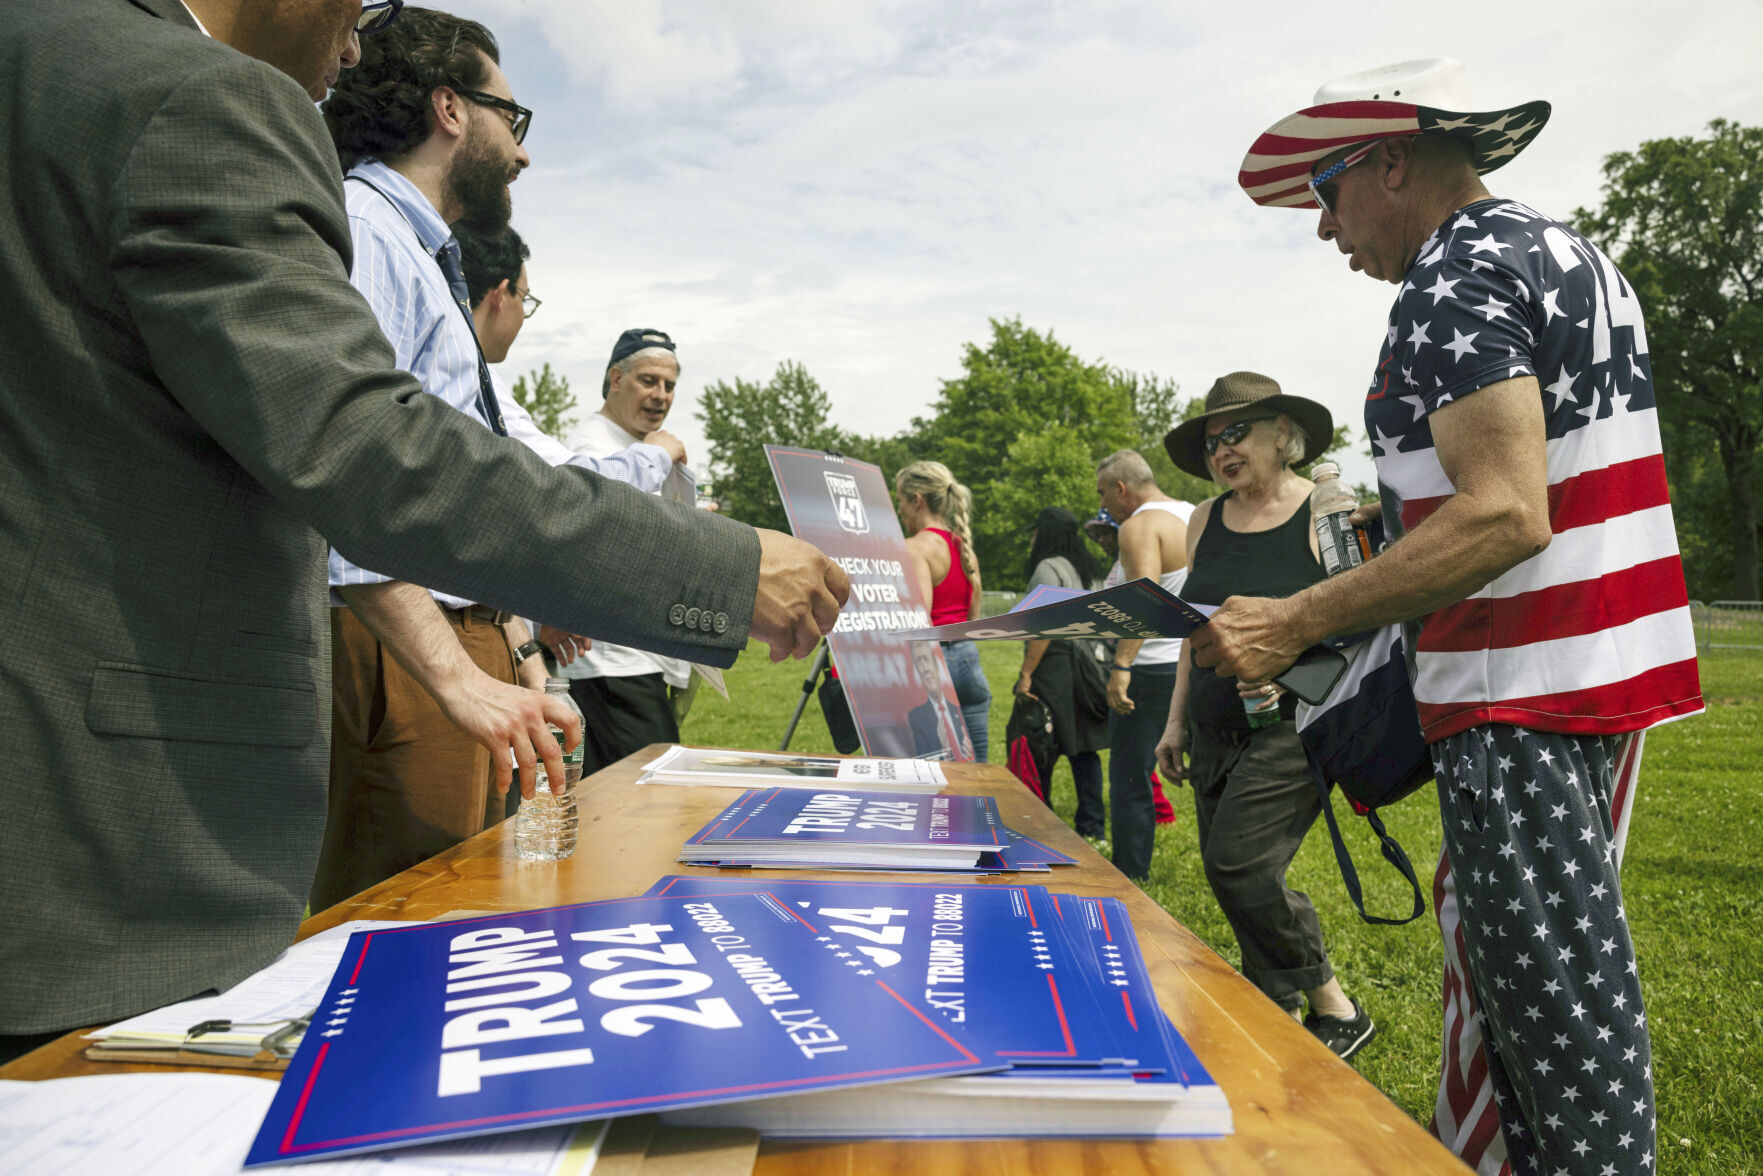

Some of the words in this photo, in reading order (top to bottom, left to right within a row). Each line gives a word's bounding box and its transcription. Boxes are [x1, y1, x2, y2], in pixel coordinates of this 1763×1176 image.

[839, 496, 864, 528] 47
[829, 556, 872, 575] HECK
[871, 558, 904, 577] YOUR
[852, 583, 900, 603] VOTER
[832, 609, 931, 634] REGISTRATION!
[1087, 600, 1132, 623] 88022
[782, 794, 863, 834] TRUMP
[856, 800, 919, 831] 2024
[682, 902, 736, 933] 88022
[932, 893, 963, 921] 88022
[711, 935, 752, 953] TO
[931, 922, 964, 937] TO
[926, 939, 965, 985] TRUMP
[570, 922, 743, 1037] 2024
[726, 953, 800, 1005] TRUMP
[437, 926, 595, 1097] TRUMP
[769, 1008, 849, 1060] TEXT
